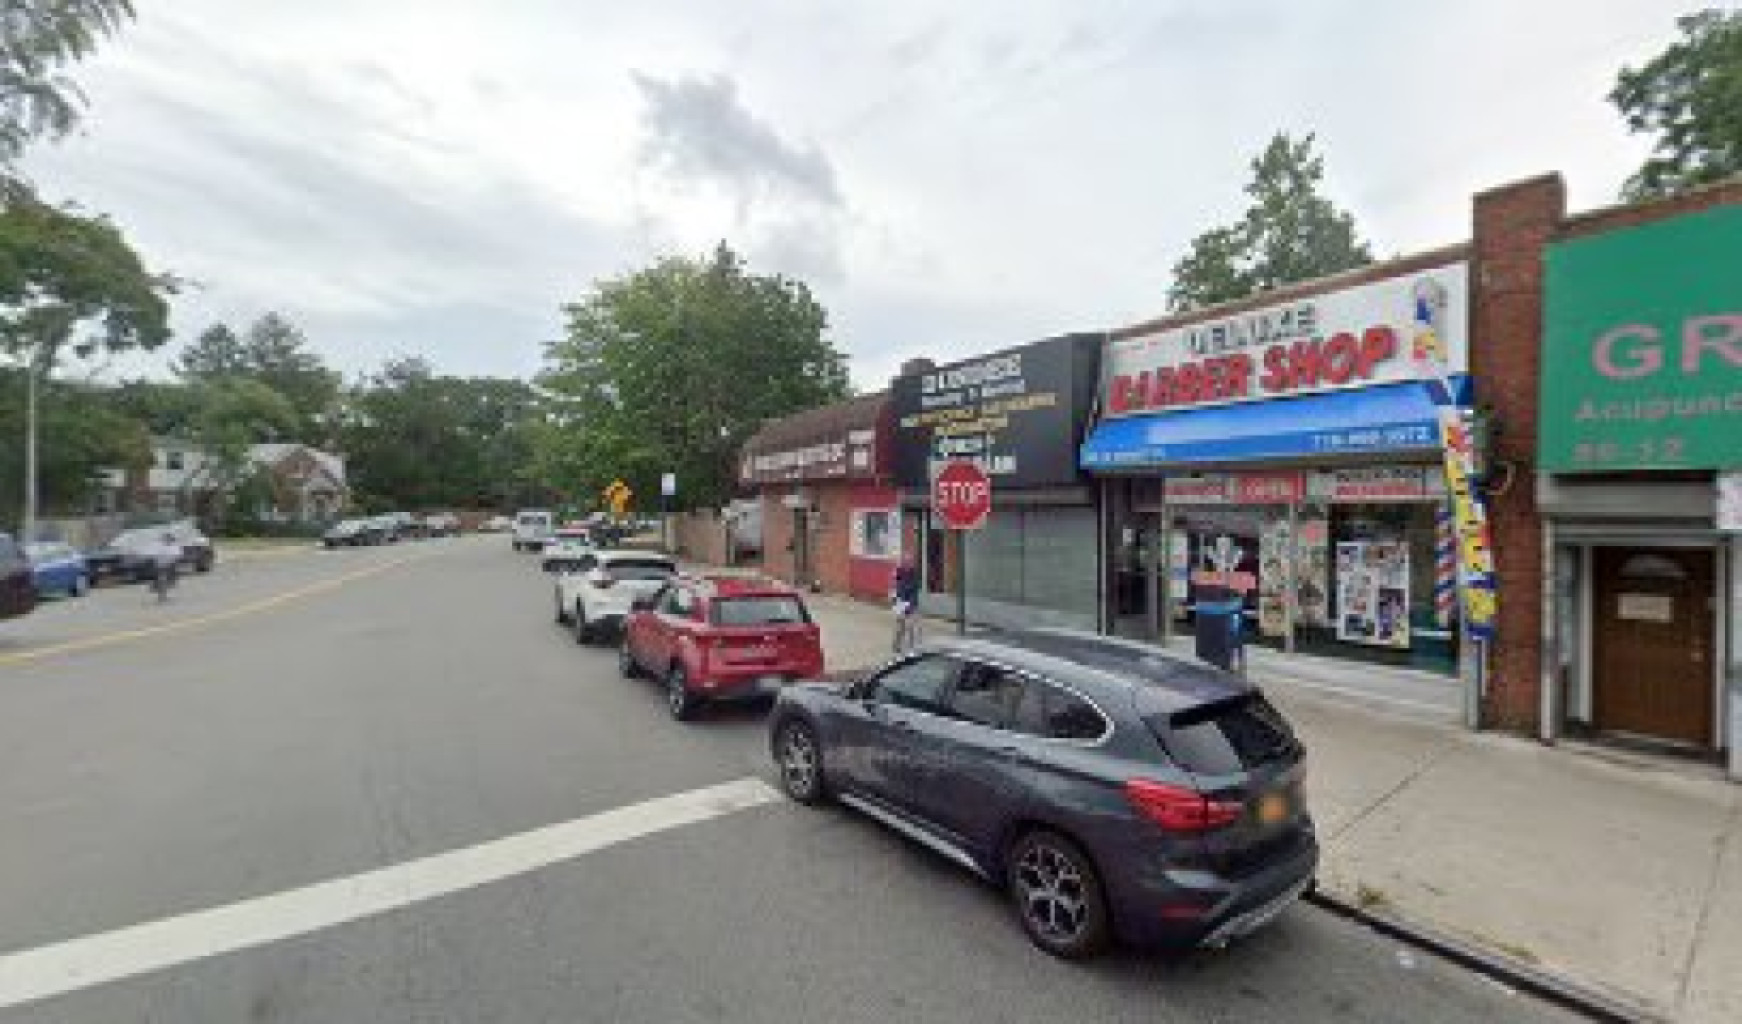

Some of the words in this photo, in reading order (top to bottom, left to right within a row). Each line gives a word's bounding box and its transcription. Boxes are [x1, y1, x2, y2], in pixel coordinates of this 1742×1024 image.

[1109, 353, 1252, 413] BARBER
[1259, 325, 1398, 393] SHOP
[1592, 313, 1742, 380] GR
[938, 481, 990, 506] STOP
